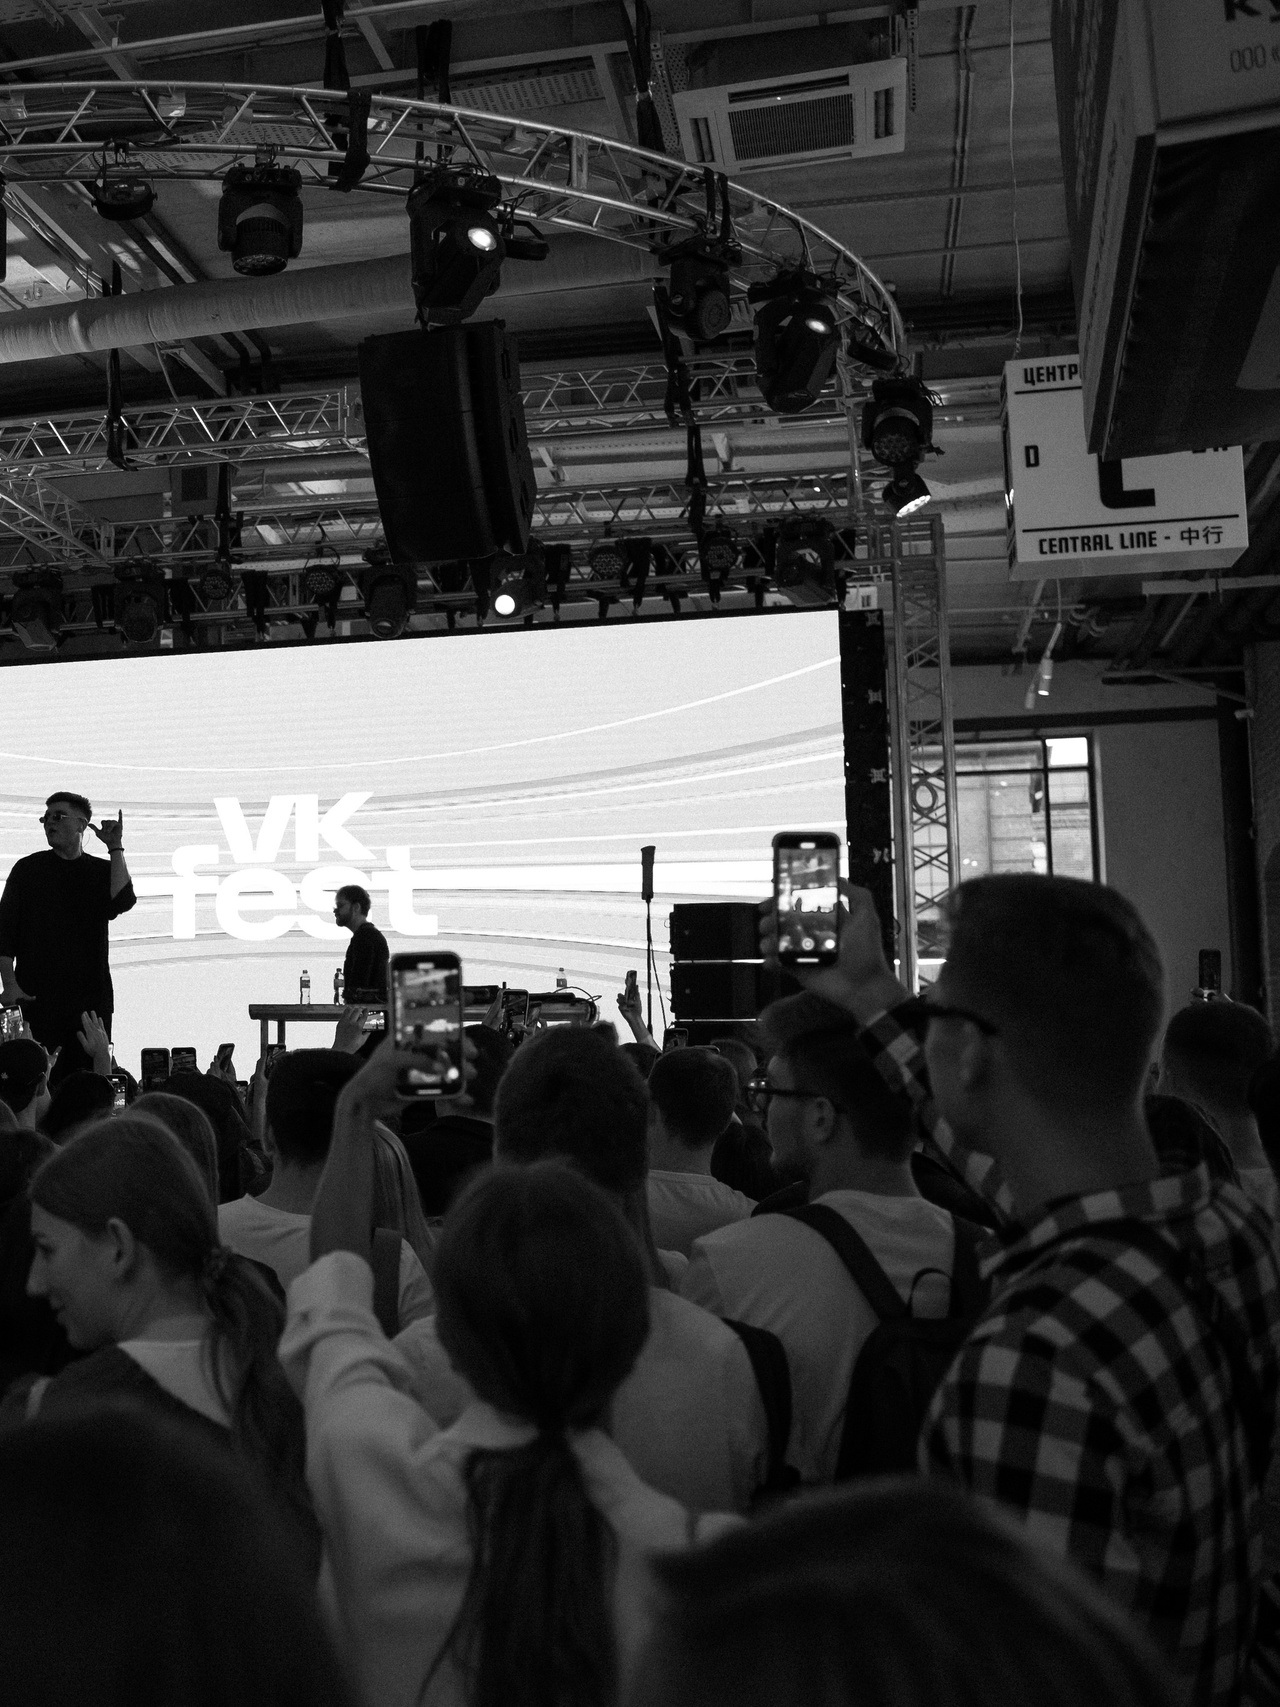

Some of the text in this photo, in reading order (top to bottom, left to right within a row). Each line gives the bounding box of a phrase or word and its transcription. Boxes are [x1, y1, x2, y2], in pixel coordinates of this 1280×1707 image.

[1039, 534, 1114, 555] CENTRAL
[1120, 531, 1157, 549] LINE
[213, 791, 377, 863] VK
[171, 843, 439, 941] fest
